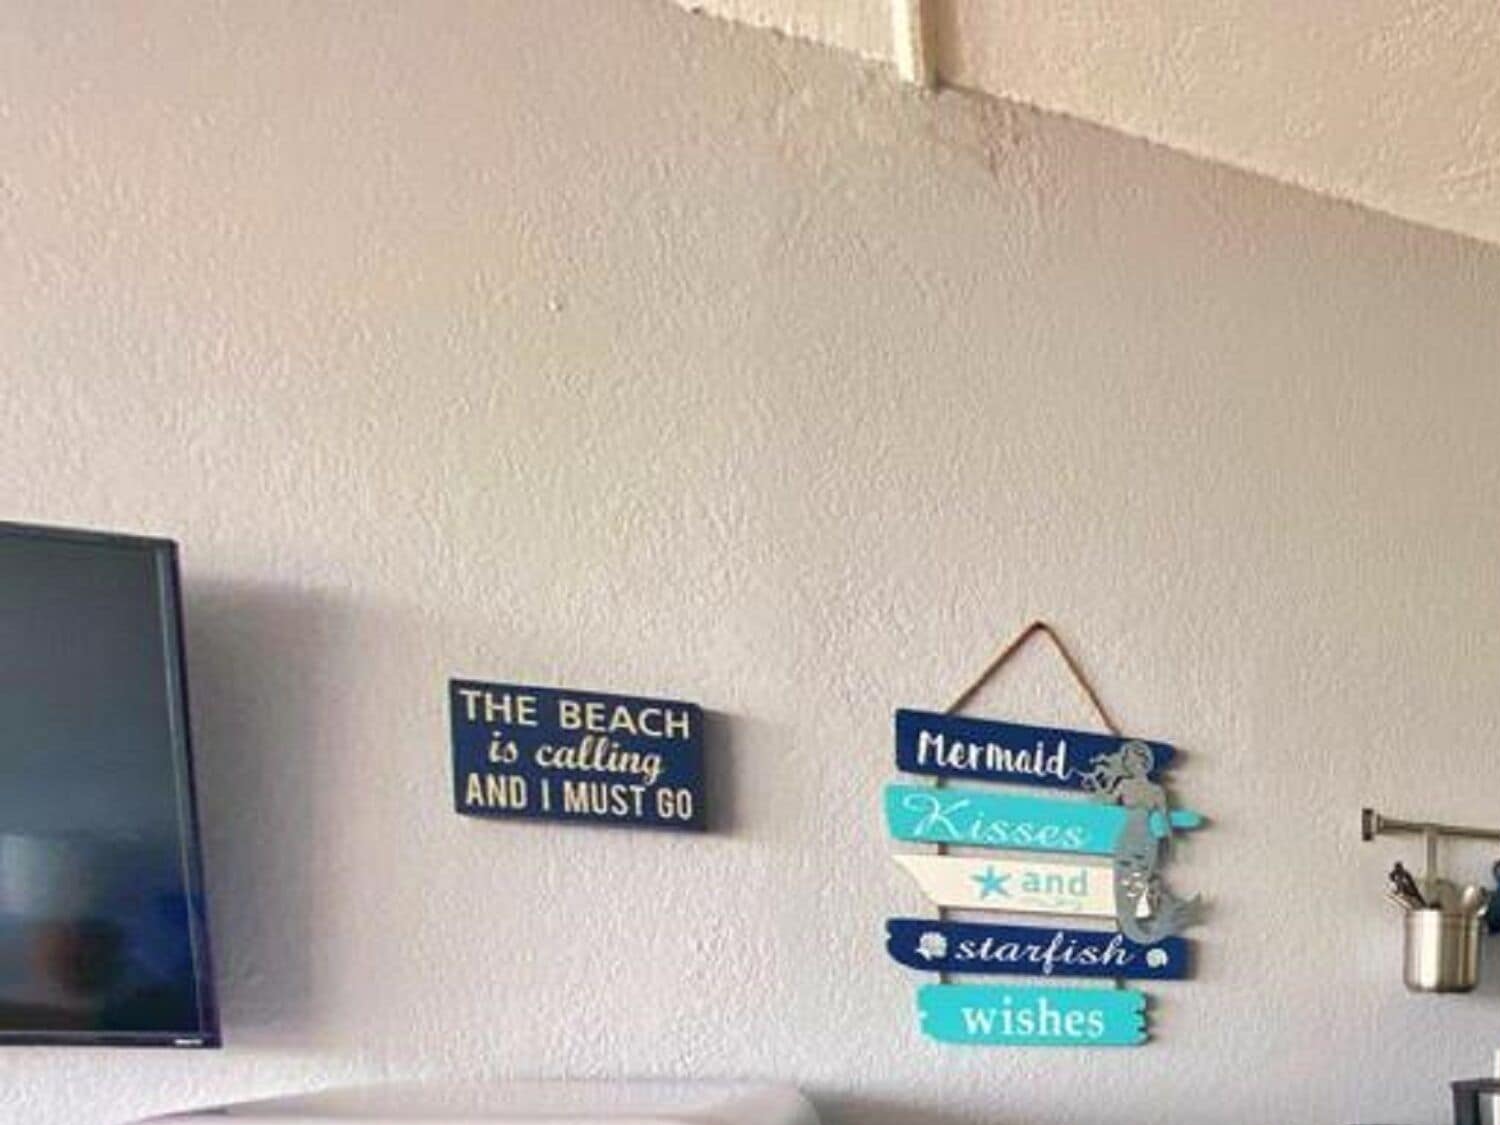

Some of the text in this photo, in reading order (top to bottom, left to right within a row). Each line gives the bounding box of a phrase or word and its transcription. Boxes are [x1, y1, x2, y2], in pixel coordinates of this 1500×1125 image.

[459, 690, 690, 740] THE BEACH
[488, 731, 663, 784] is calling
[917, 730, 1074, 780] Mermaid
[466, 772, 692, 820] AND I MUST GO
[903, 793, 1086, 849] Kisses
[1022, 868, 1089, 897] and
[955, 932, 1133, 975] starfish
[961, 996, 1105, 1038] wishes
